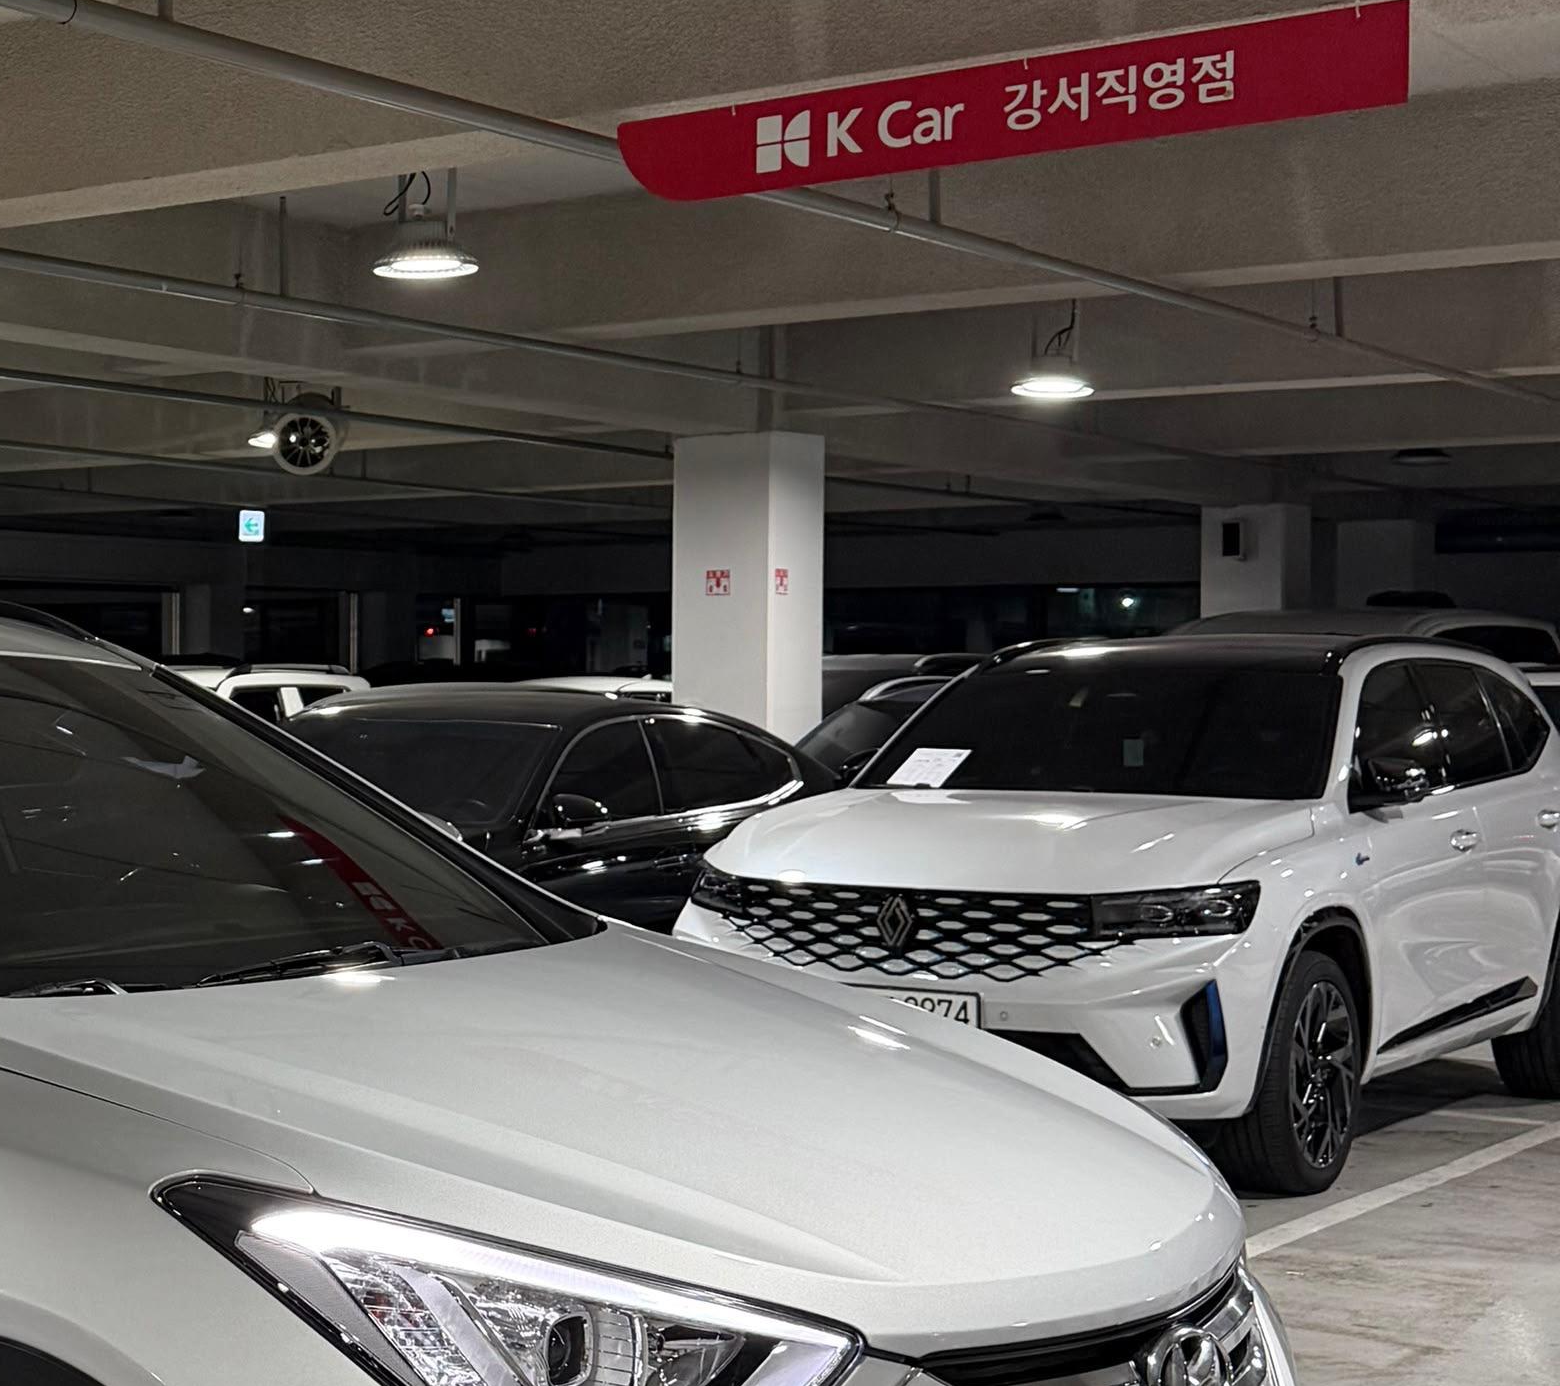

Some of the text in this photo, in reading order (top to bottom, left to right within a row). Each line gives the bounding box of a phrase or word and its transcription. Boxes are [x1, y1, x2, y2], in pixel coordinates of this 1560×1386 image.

[826, 50, 1235, 158] K Car 강서직영점
